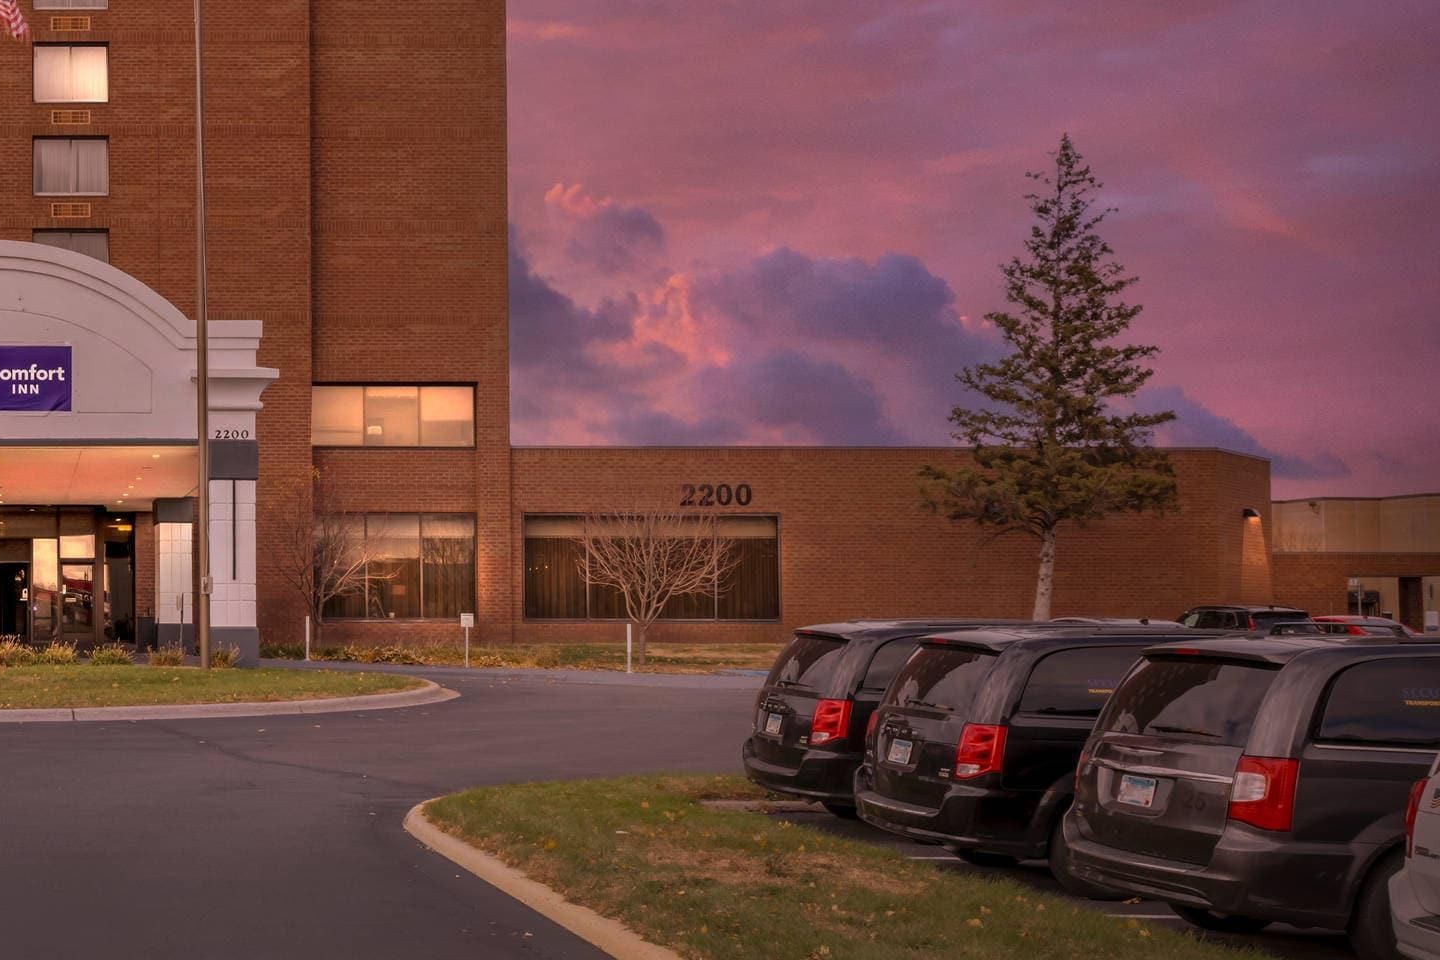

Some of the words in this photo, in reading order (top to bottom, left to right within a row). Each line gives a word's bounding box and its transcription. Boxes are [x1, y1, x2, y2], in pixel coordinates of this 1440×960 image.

[11, 383, 40, 396] INN
[215, 429, 249, 440] 2200
[679, 483, 753, 507] 2200
